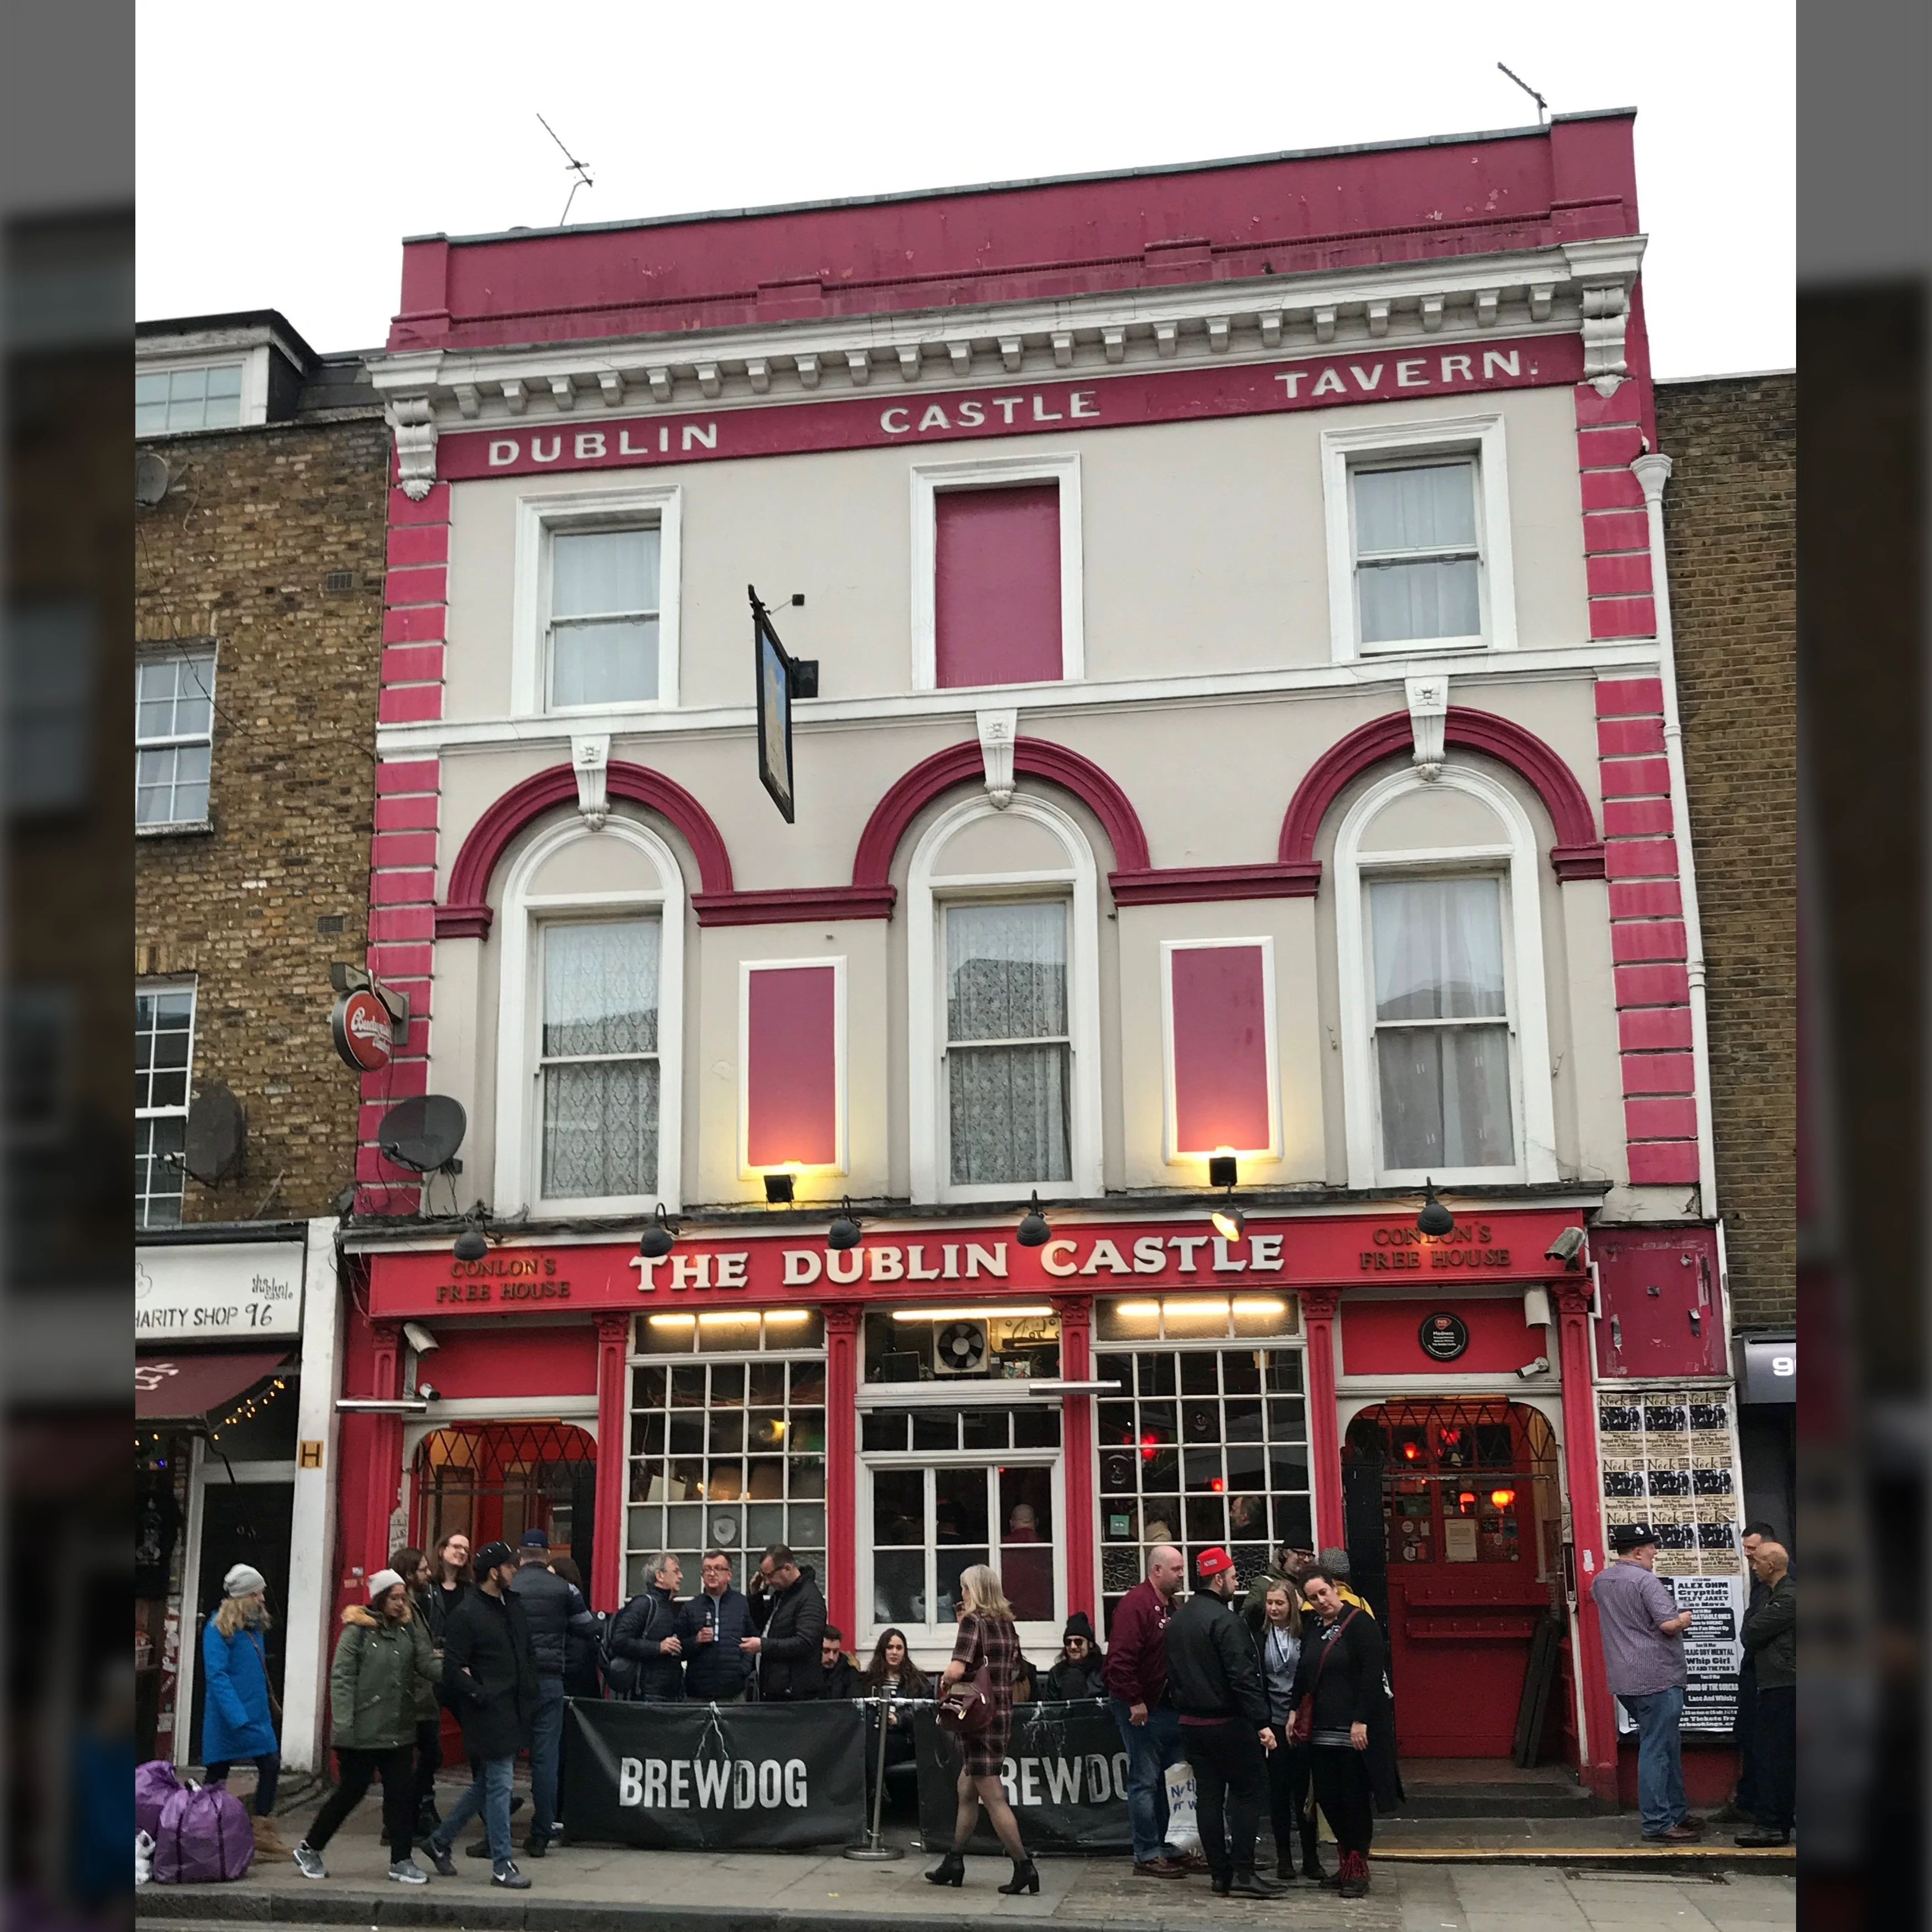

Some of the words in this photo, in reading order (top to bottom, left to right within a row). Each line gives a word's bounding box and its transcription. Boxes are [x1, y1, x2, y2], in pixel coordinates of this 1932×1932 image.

[489, 423, 719, 467] DUBLIN
[881, 391, 1101, 433] CASTLE
[451, 1255, 556, 1278] CONLON'S
[629, 1252, 748, 1290] THE
[782, 1242, 1008, 1286] DUBLIN
[1041, 1235, 1284, 1275] CASTLE
[1361, 1252, 1420, 1269] FREE
[1432, 1248, 1510, 1267] HOUSE
[436, 1284, 492, 1302] FREE
[500, 1281, 570, 1300] HOUSE
[135, 1308, 189, 1328] HARITY
[194, 1307, 239, 1326] SHOP
[245, 1303, 272, 1327] 96
[1772, 1357, 1796, 1376] 9
[302, 1444, 321, 1466] H
[1647, 1458, 1678, 1470] Neck
[1652, 1511, 1682, 1523] Neck
[619, 1757, 807, 1809] BREWDOG
[1000, 1752, 1130, 1806] REWDO
